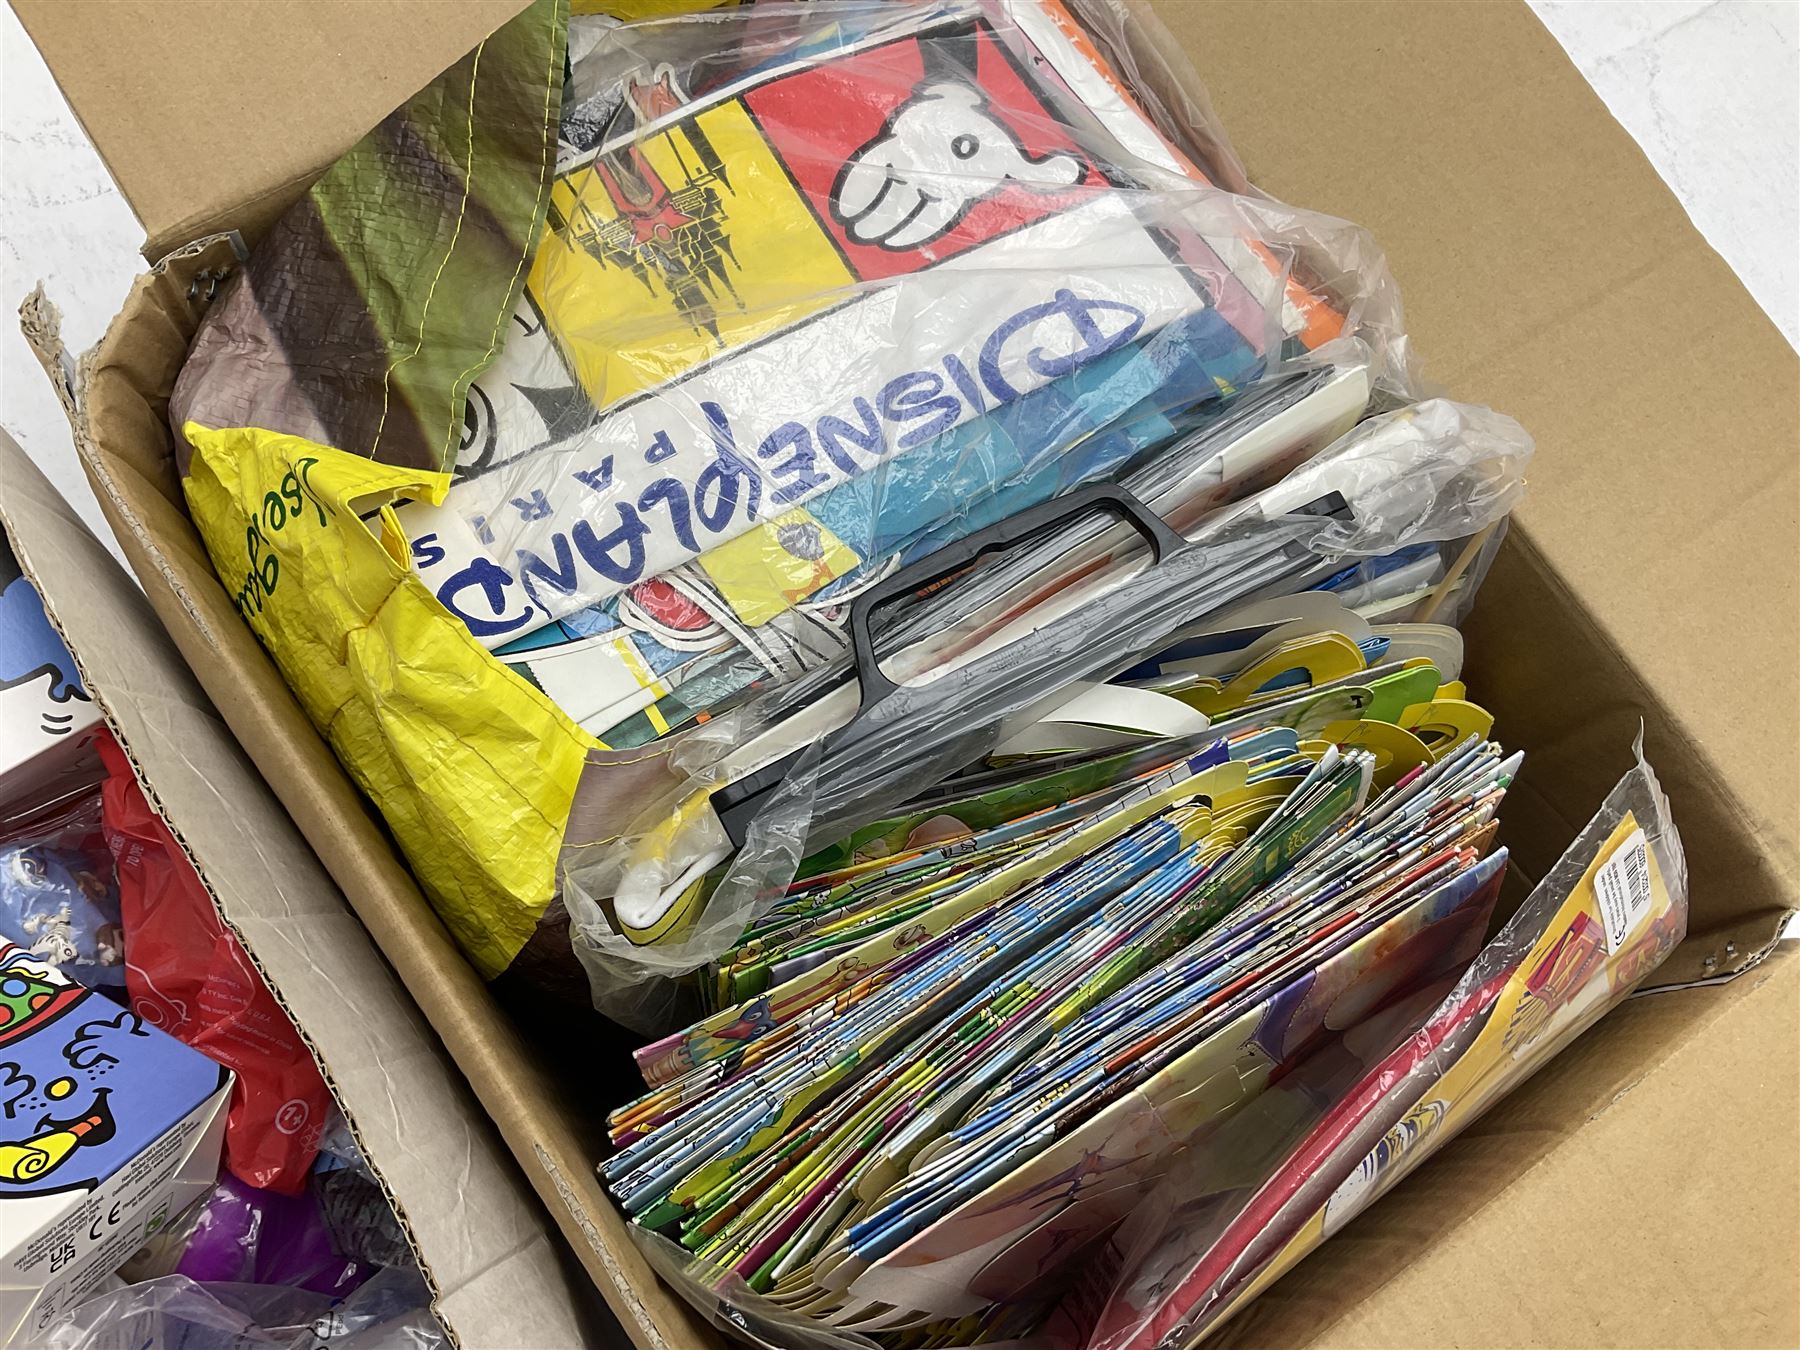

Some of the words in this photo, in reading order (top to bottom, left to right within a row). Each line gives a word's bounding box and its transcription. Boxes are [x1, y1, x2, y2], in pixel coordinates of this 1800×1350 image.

[410, 430, 679, 570] PARIS
[437, 288, 1147, 637] DISNEYLAND
[50, 1239, 75, 1262] UK
